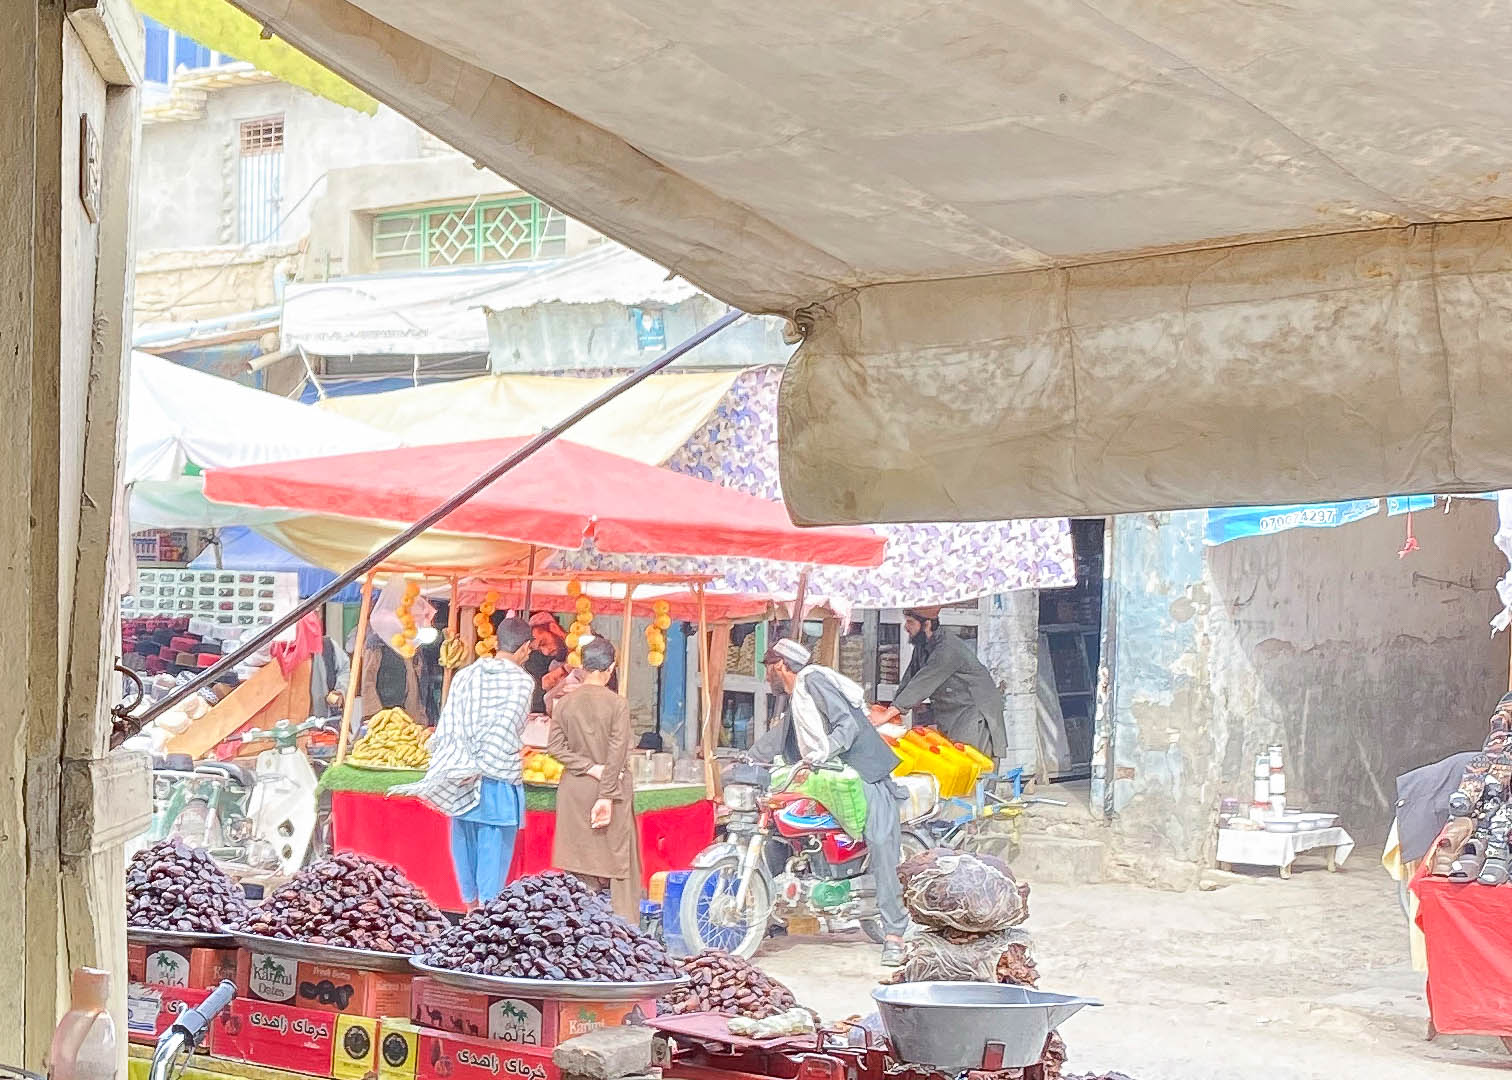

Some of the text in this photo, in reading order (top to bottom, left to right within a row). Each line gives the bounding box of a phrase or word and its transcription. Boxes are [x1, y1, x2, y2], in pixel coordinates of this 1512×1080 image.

[250, 1012, 329, 1040] خرمای زاهدی
[457, 1048, 500, 1074] زاهدی
